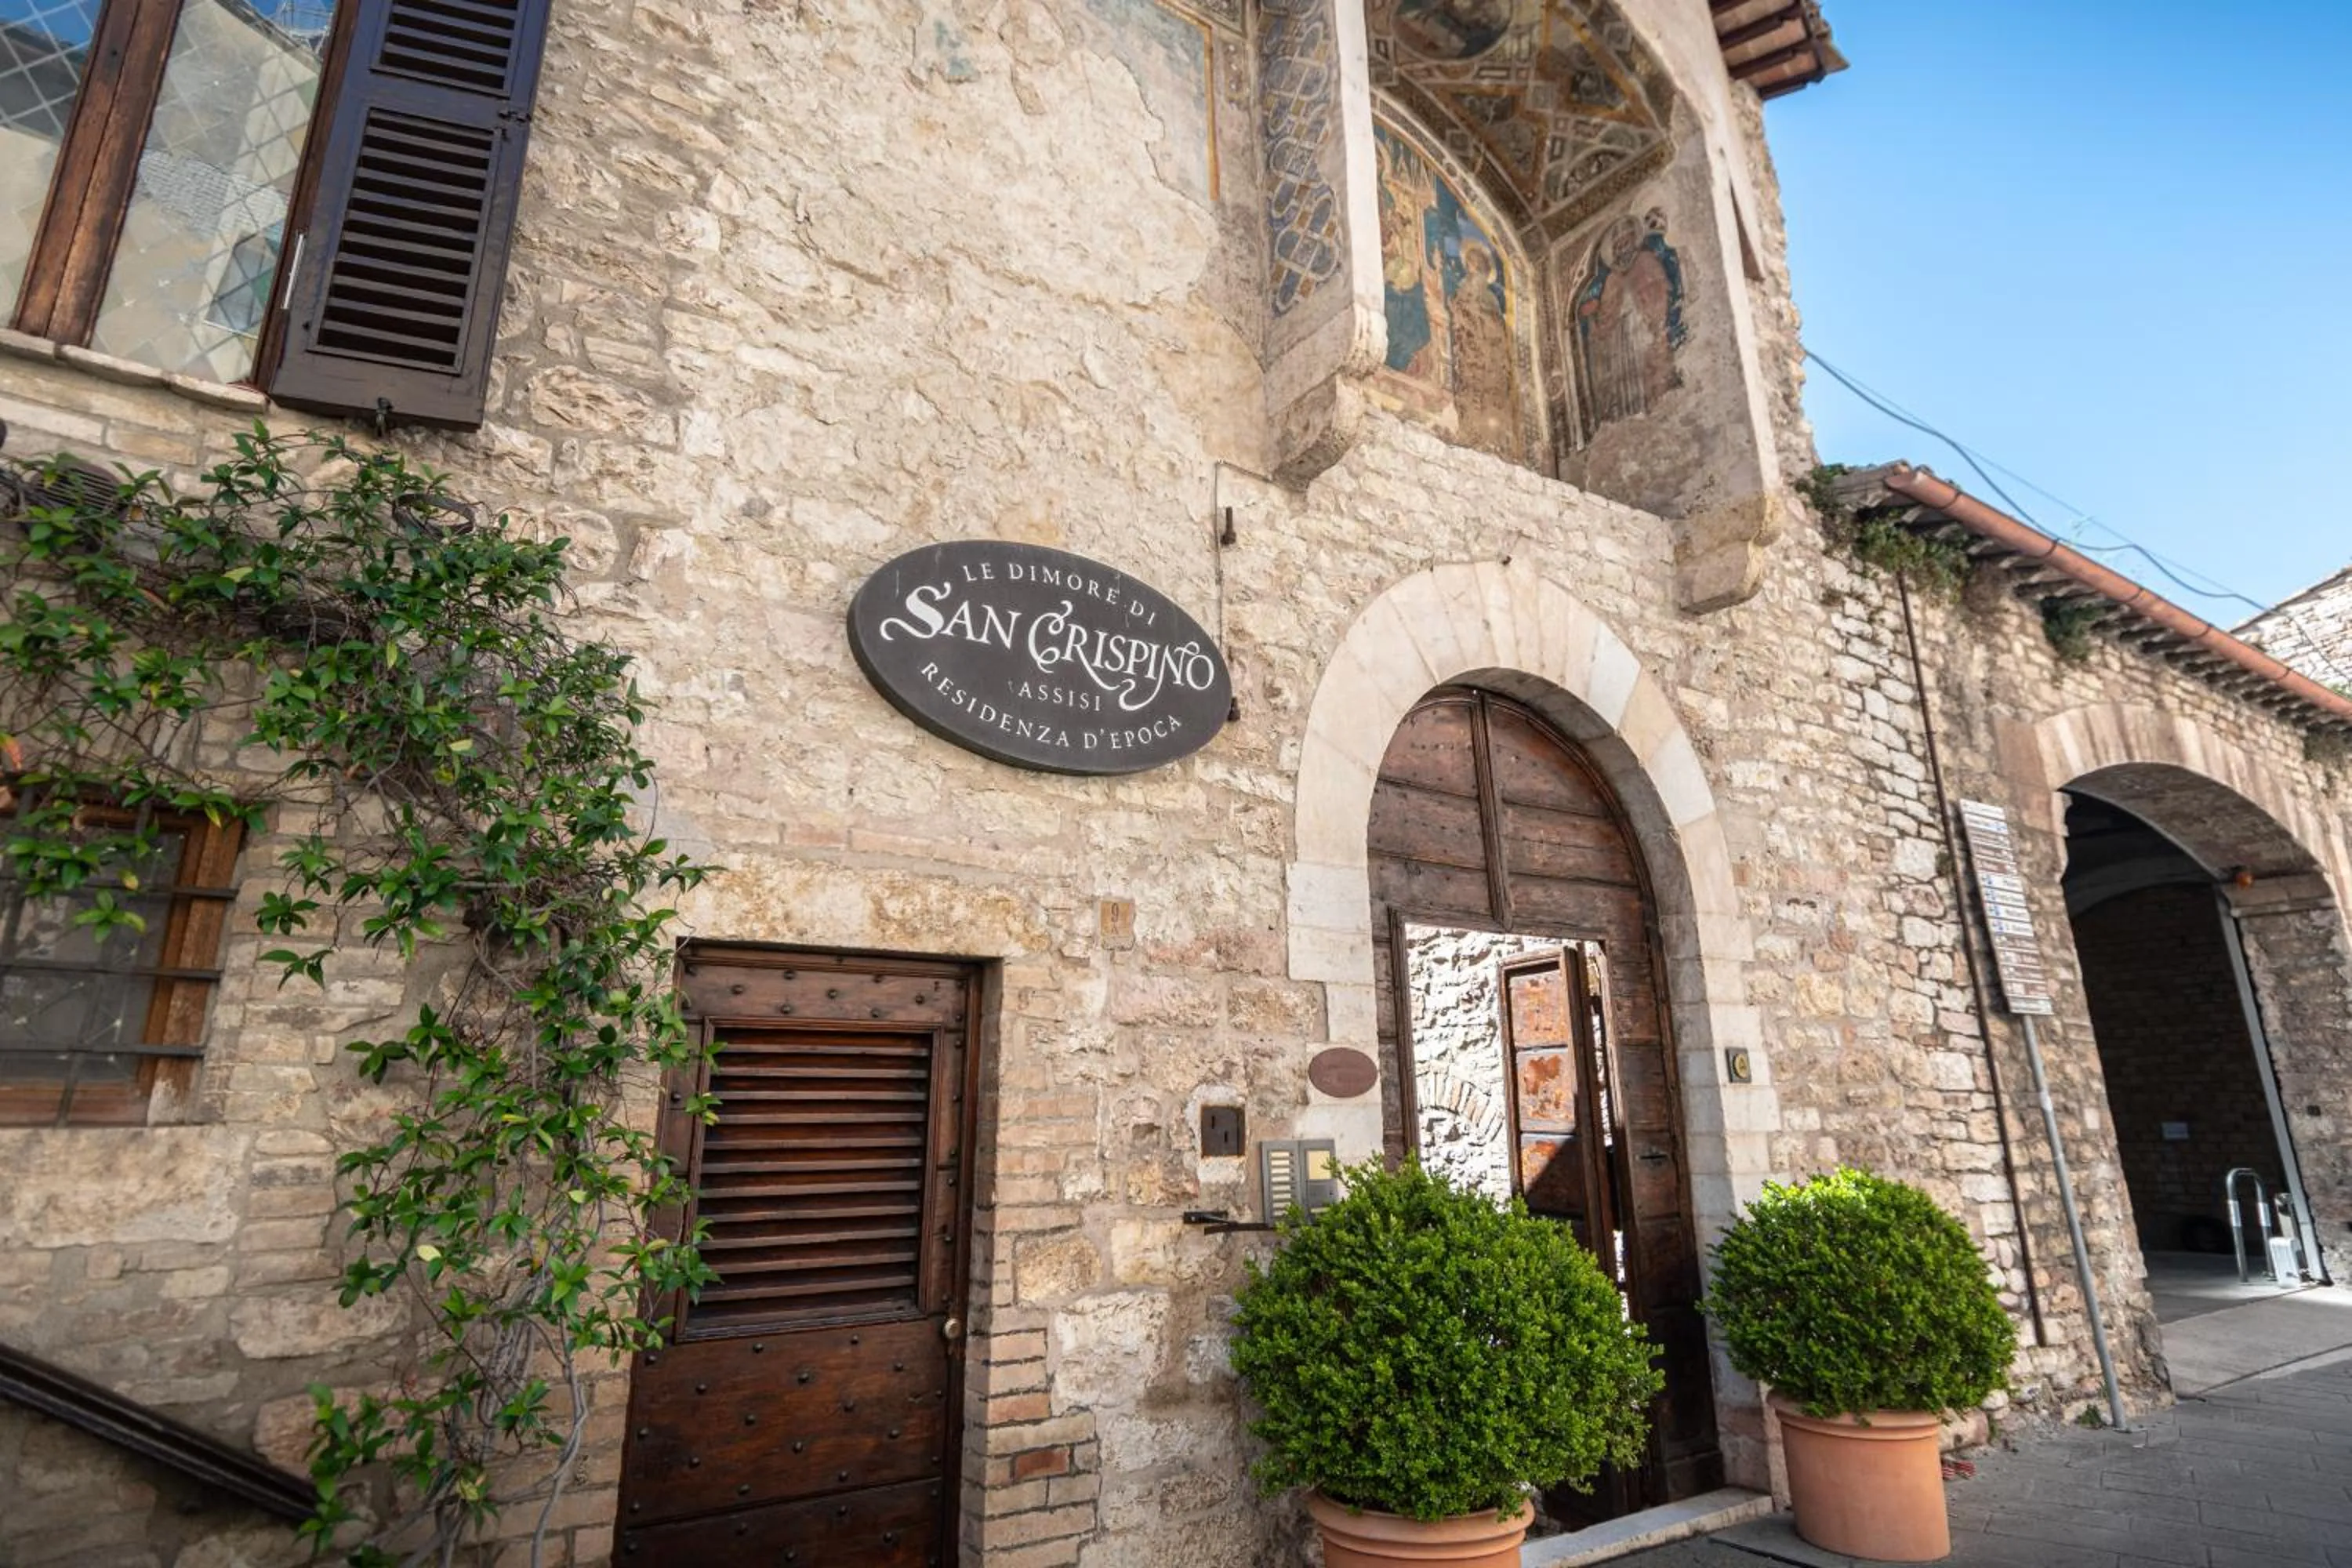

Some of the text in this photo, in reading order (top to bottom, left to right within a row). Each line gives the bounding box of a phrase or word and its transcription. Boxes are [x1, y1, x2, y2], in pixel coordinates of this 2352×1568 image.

[962, 562, 1156, 626] LE DIMORE DI
[879, 581, 1215, 712] SAN CRISPINO
[920, 662, 1181, 750] RESIDENZA D'EPOCA
[1018, 680, 1100, 712] ASSISI
